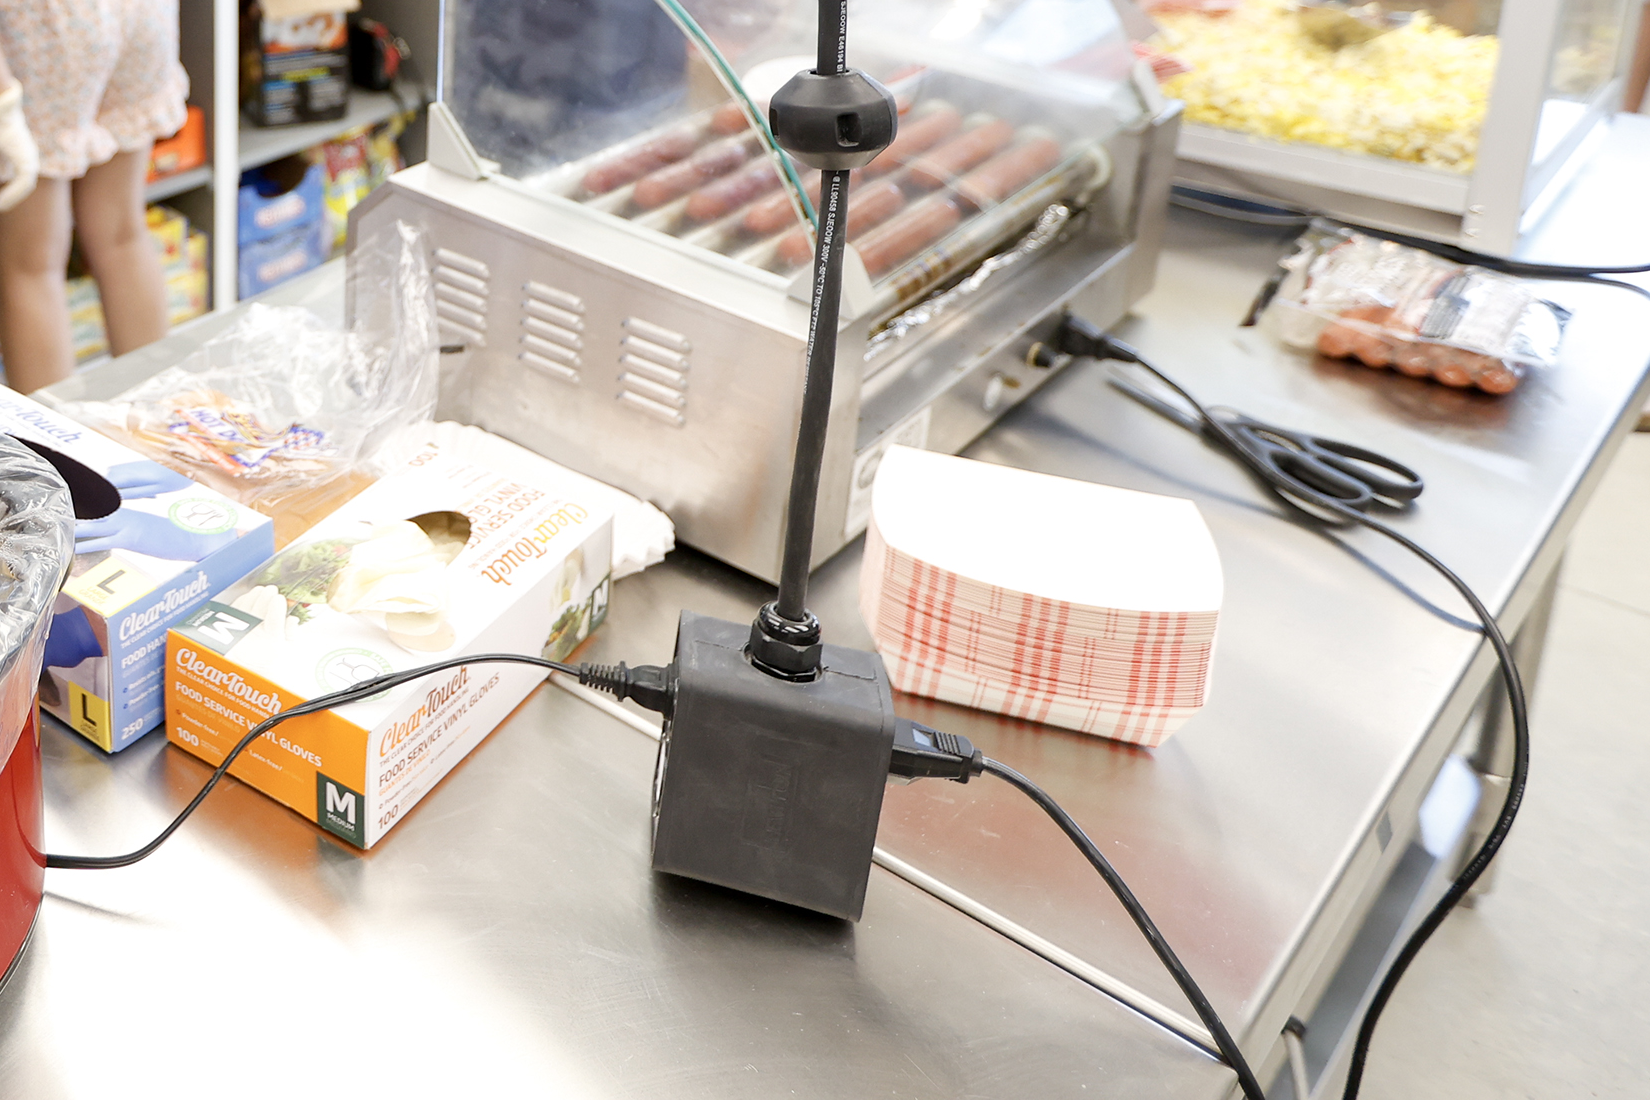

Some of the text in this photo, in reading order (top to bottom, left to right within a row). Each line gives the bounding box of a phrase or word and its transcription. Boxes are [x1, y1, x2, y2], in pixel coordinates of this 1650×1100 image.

[481, 503, 588, 586] ClearTouch
[97, 569, 126, 595] L
[119, 571, 208, 642] ClearTouch
[198, 612, 250, 645] M
[121, 647, 147, 669] FOOD
[175, 648, 282, 715] ClearTouch
[81, 693, 97, 726] L
[175, 681, 202, 703] FOOD
[204, 697, 246, 727] SERVICE
[279, 738, 322, 767] GLOVES
[380, 665, 467, 757] ClearTouch
[121, 718, 144, 740] 250
[176, 726, 199, 747] 100
[379, 759, 406, 788] FOOD
[407, 725, 442, 765] SERVICE
[444, 705, 468, 731] VINYL
[469, 672, 500, 708] GLOVES
[326, 781, 356, 824] M
[378, 804, 398, 829] 100
